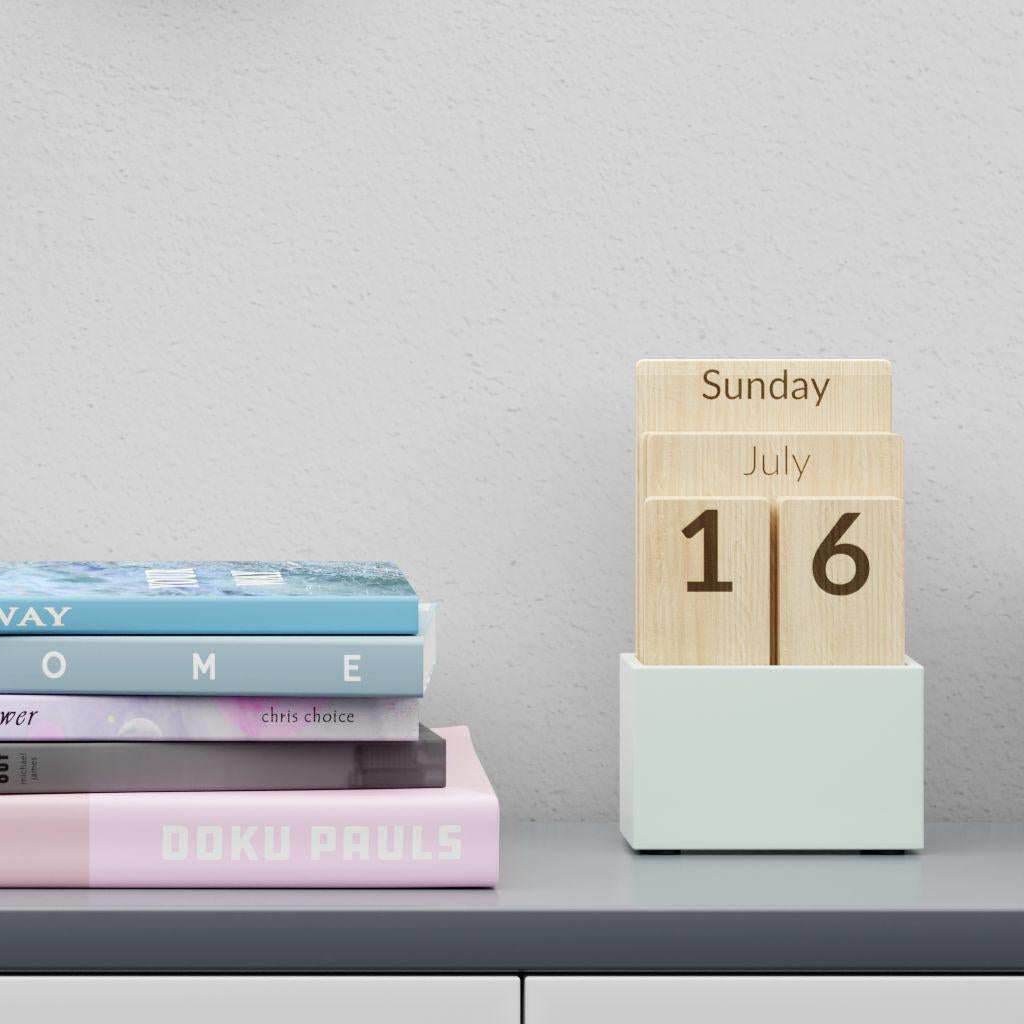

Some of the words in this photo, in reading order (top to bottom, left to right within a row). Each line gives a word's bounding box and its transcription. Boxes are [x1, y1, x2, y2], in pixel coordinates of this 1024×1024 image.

[702, 369, 831, 407] Sunday
[743, 445, 811, 483] July
[261, 706, 298, 724] chris
[304, 706, 355, 724] choice
[18, 752, 28, 785] michael
[30, 756, 40, 782] james
[161, 824, 292, 862] DOKU
[309, 823, 463, 861] PAULS
